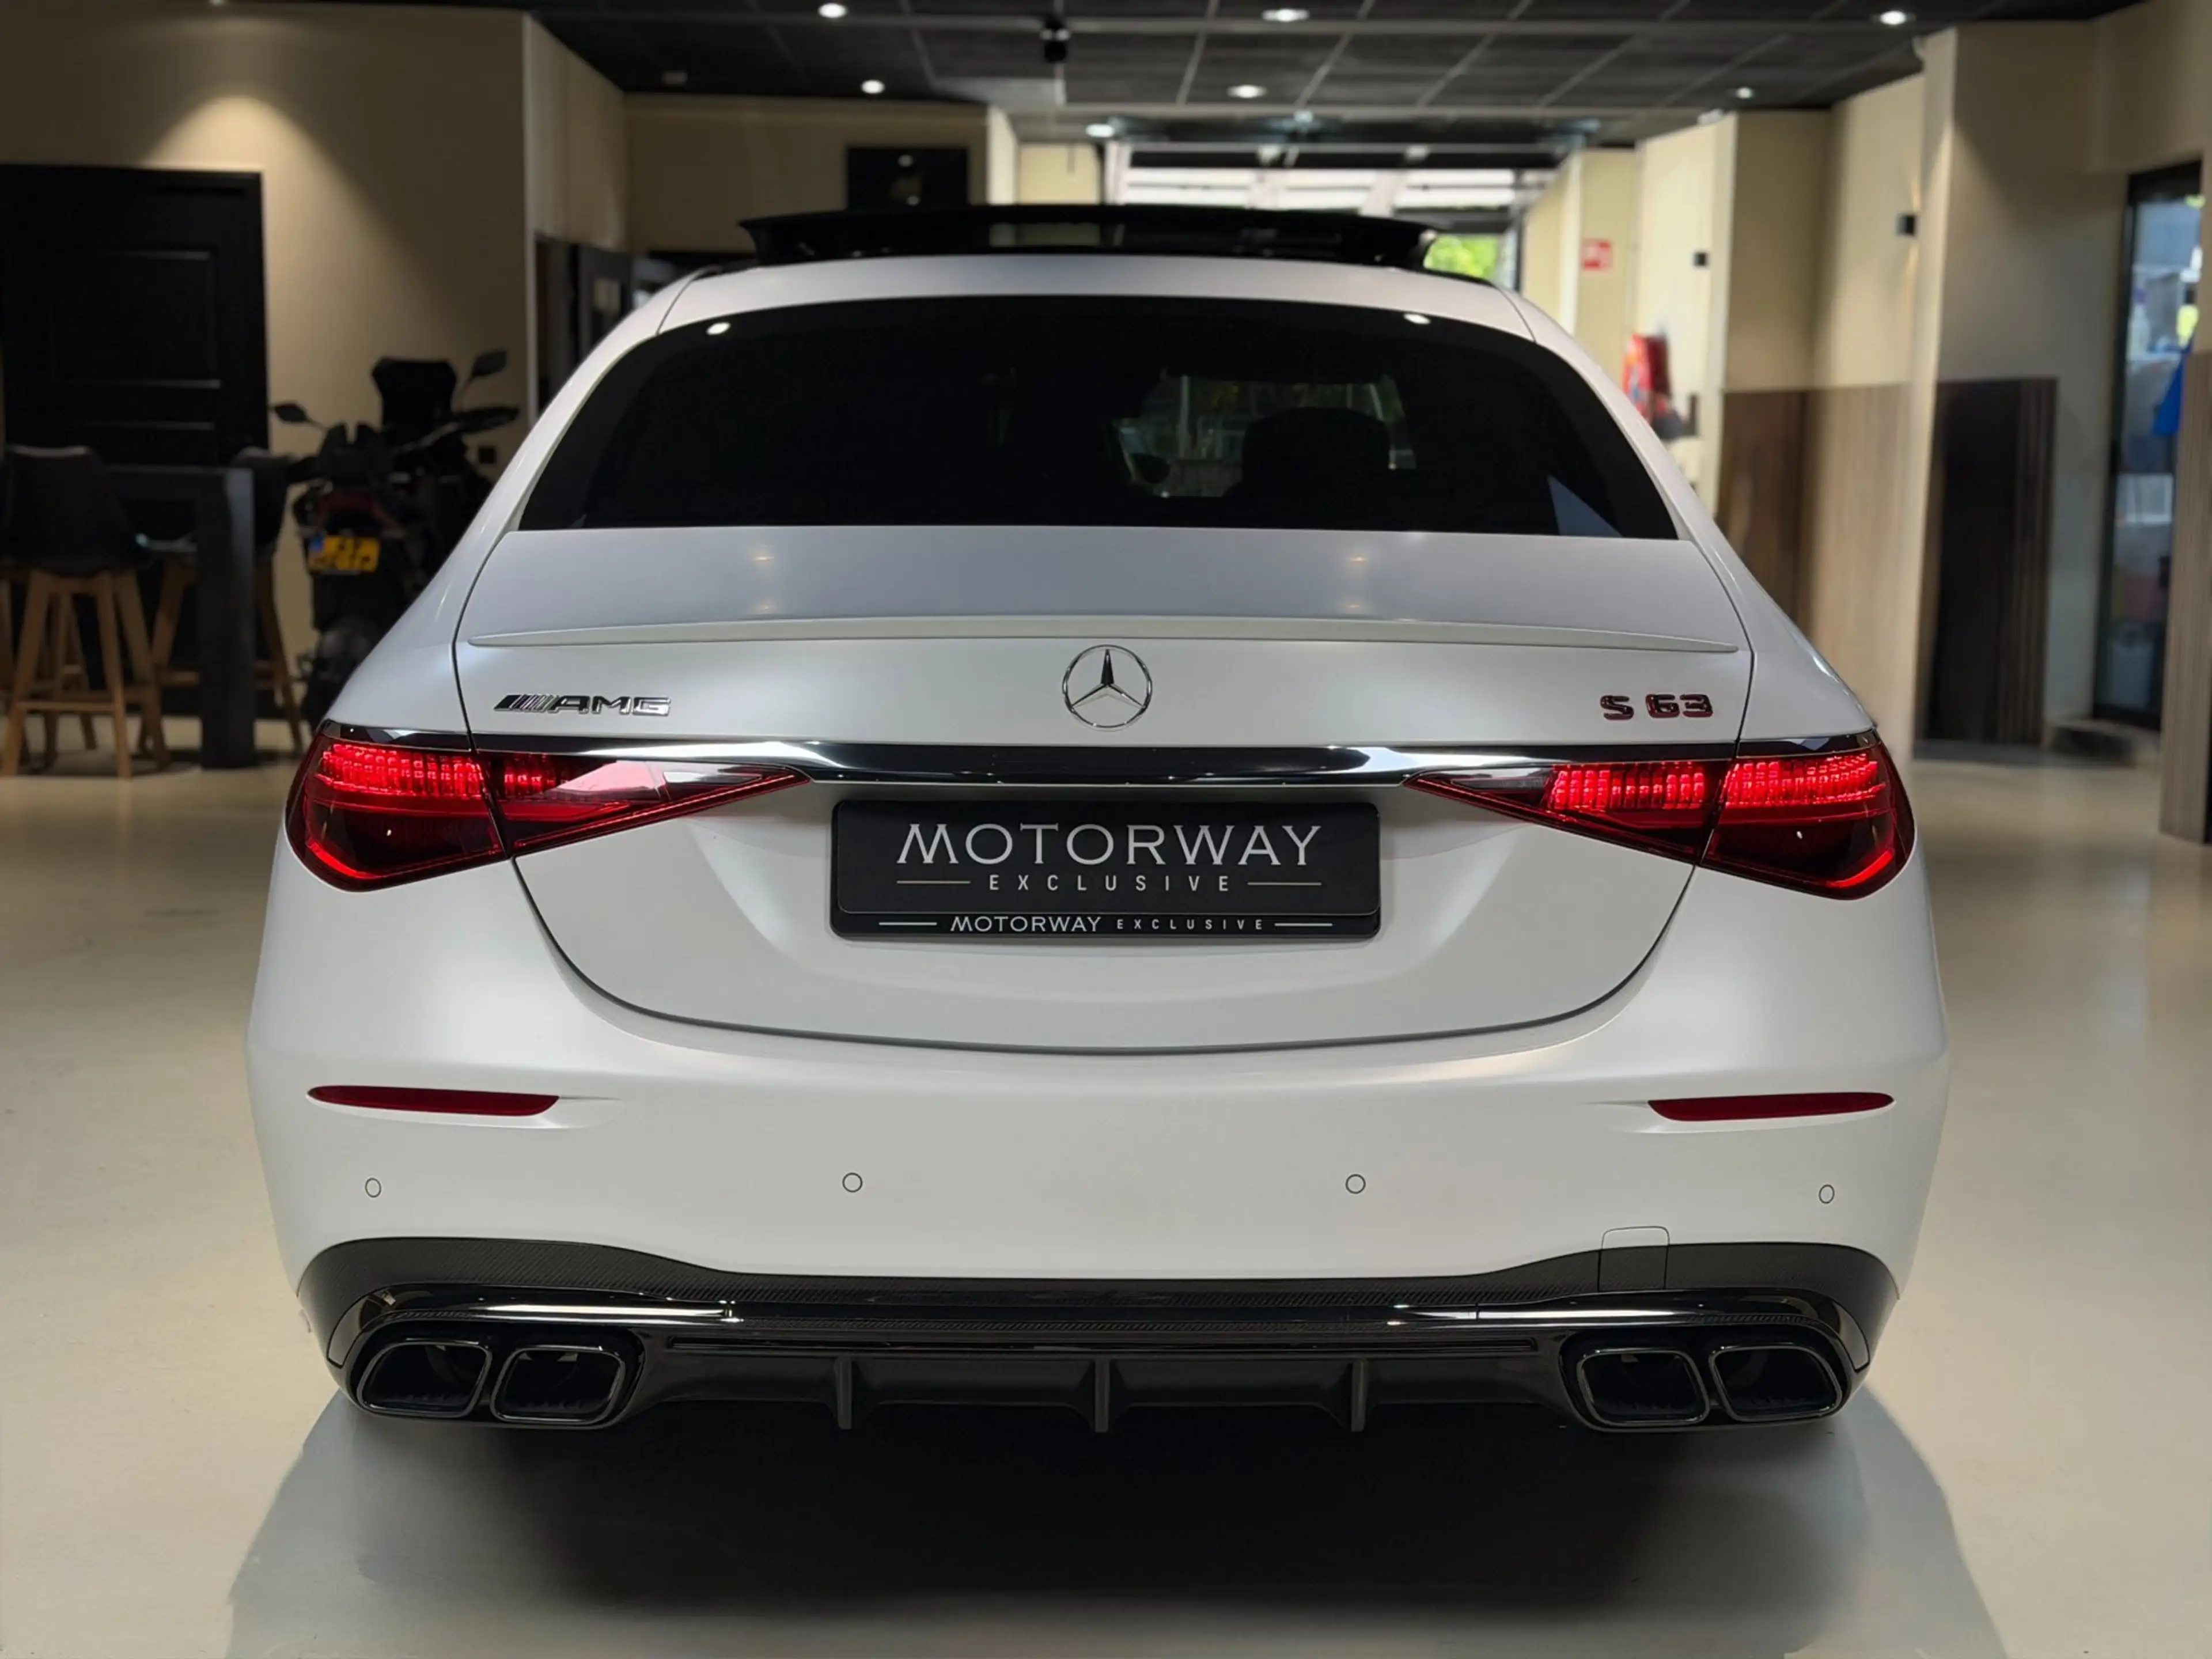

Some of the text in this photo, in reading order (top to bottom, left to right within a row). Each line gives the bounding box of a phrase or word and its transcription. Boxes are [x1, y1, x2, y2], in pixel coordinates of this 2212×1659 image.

[1600, 694, 1713, 720] S 63
[896, 823, 1321, 866] MOTORWAY
[989, 874, 1229, 892] EXCLUSIVE
[950, 916, 1263, 933] MOTORWAY EXCLUSIVE
